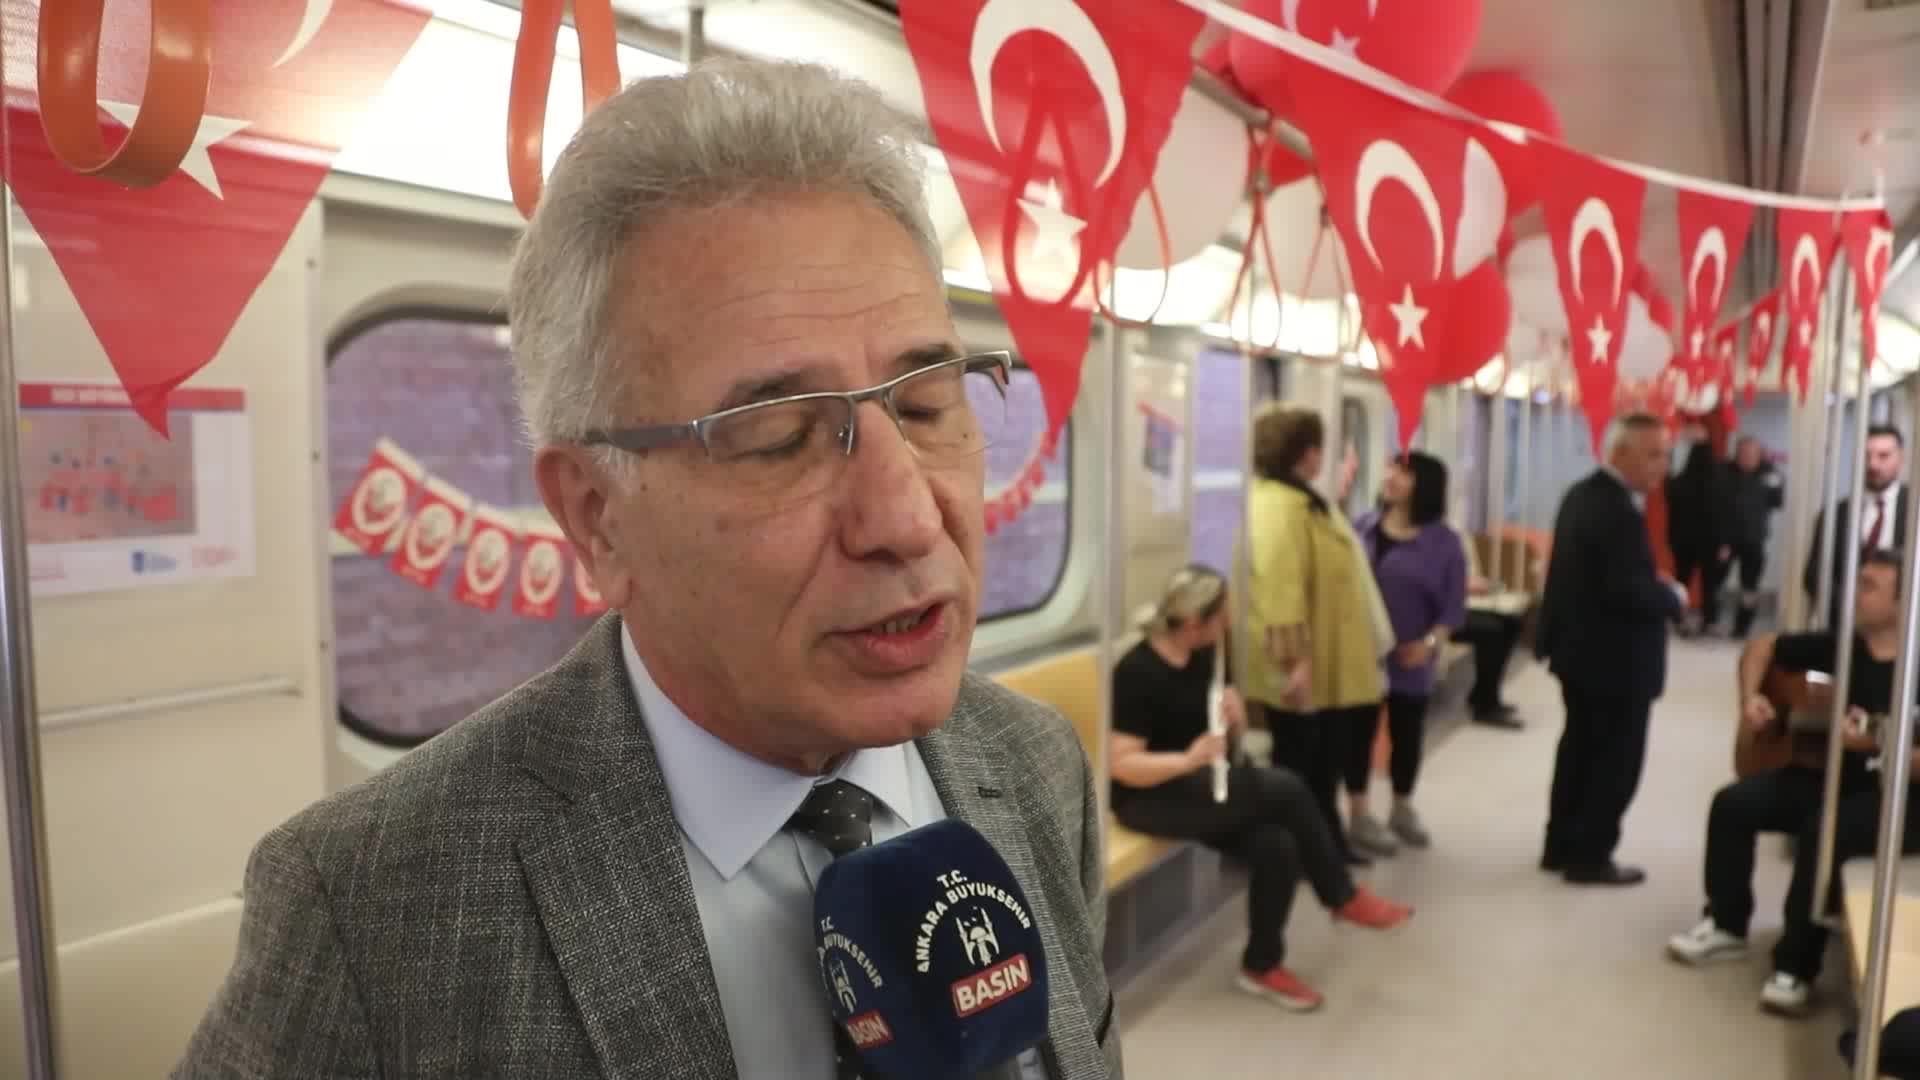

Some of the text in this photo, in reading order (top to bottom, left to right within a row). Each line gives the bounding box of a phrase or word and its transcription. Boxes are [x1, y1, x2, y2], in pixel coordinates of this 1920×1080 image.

[936, 869, 968, 888] T.C.
[916, 901, 948, 973] ANKARA
[956, 960, 1029, 1012] BASIN
